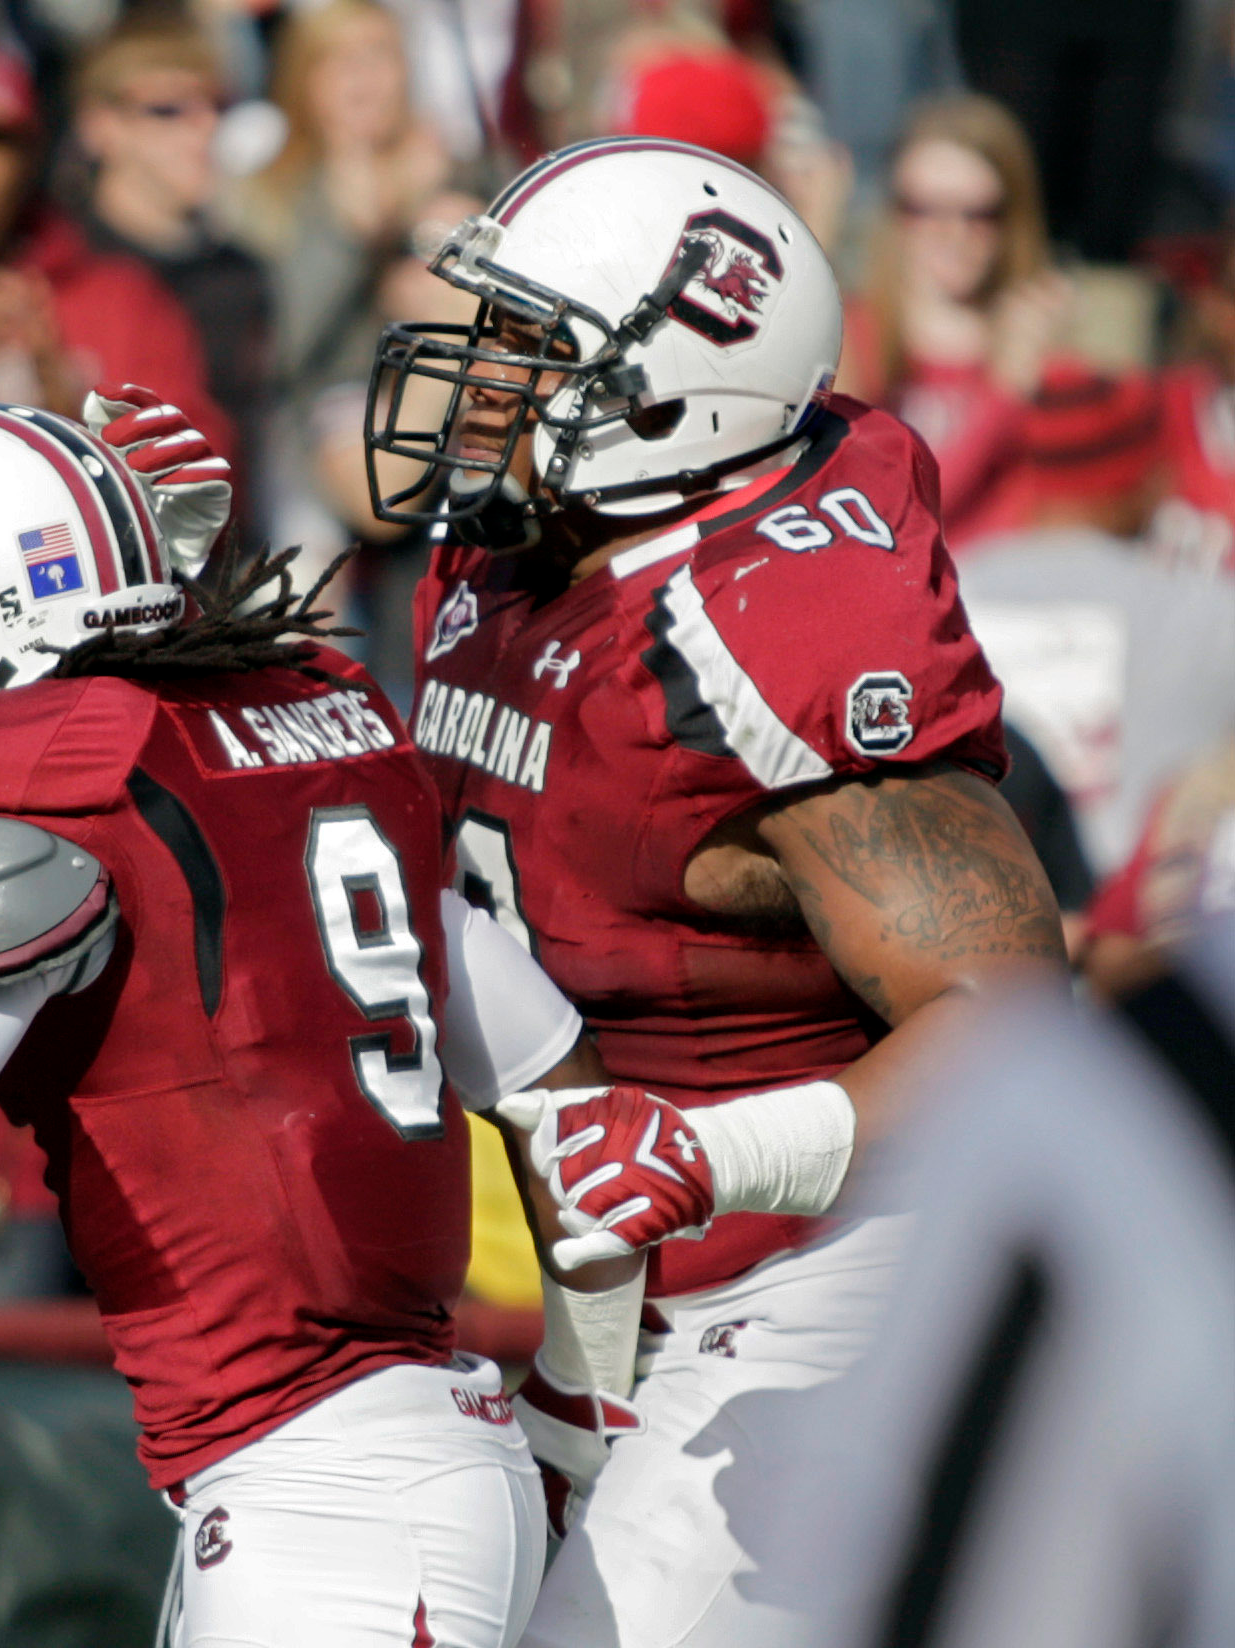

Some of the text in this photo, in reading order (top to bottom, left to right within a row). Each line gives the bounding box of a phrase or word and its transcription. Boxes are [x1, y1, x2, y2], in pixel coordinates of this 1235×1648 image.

[754, 486, 896, 553] 60
[207, 688, 396, 769] A. SANDERS
[414, 677, 554, 793] CAROLINA
[302, 801, 445, 1143] 9
